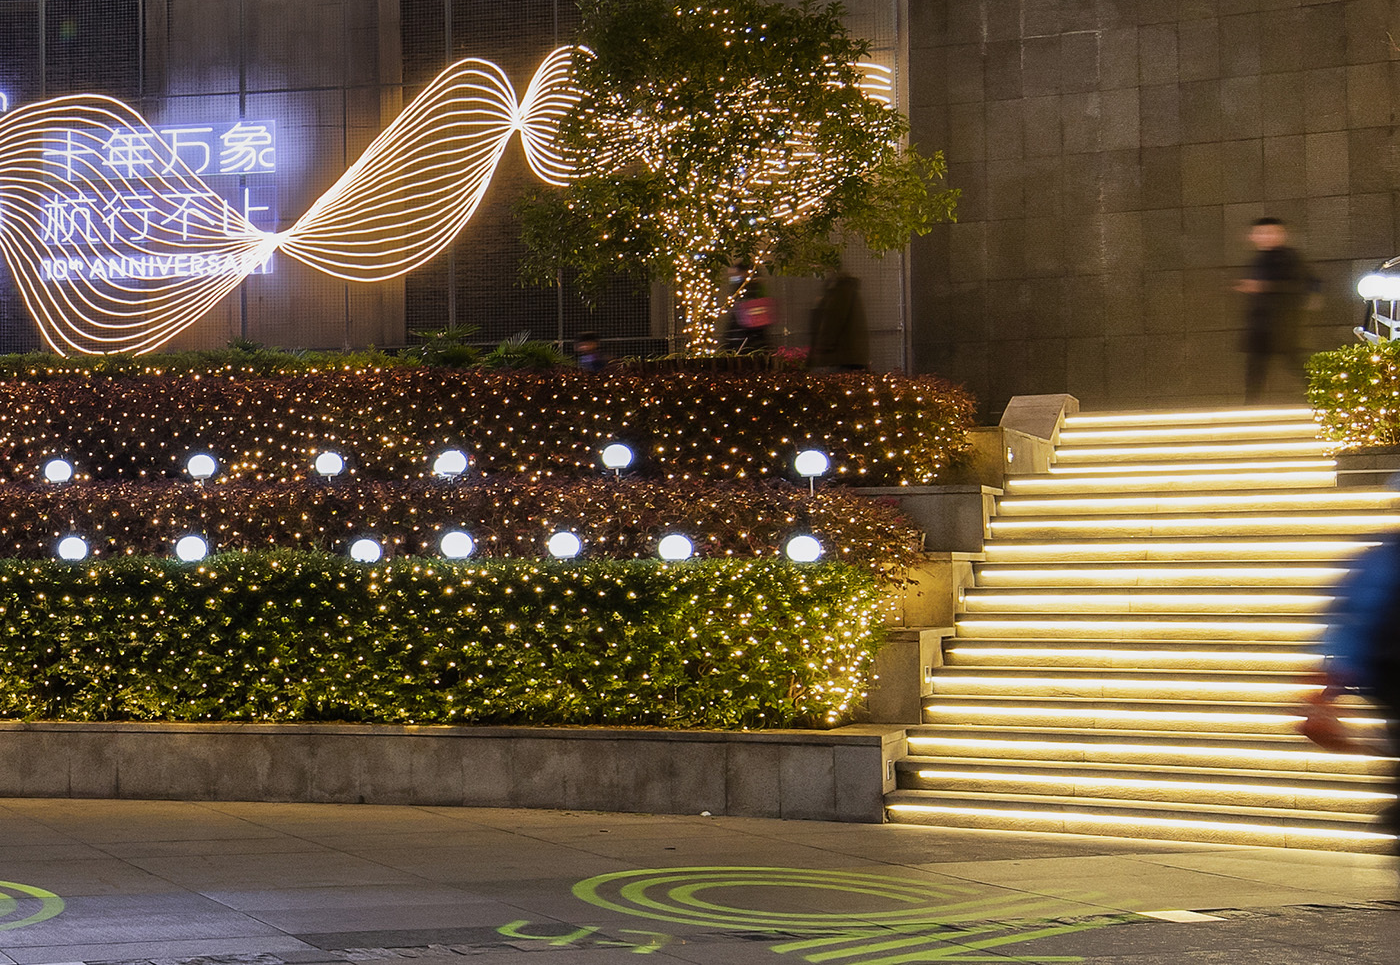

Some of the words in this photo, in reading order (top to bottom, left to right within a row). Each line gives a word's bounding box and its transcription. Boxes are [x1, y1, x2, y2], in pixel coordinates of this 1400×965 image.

[43, 122, 275, 181] 十年万象
[43, 188, 272, 245] 杭行不止
[42, 258, 84, 280] 10th
